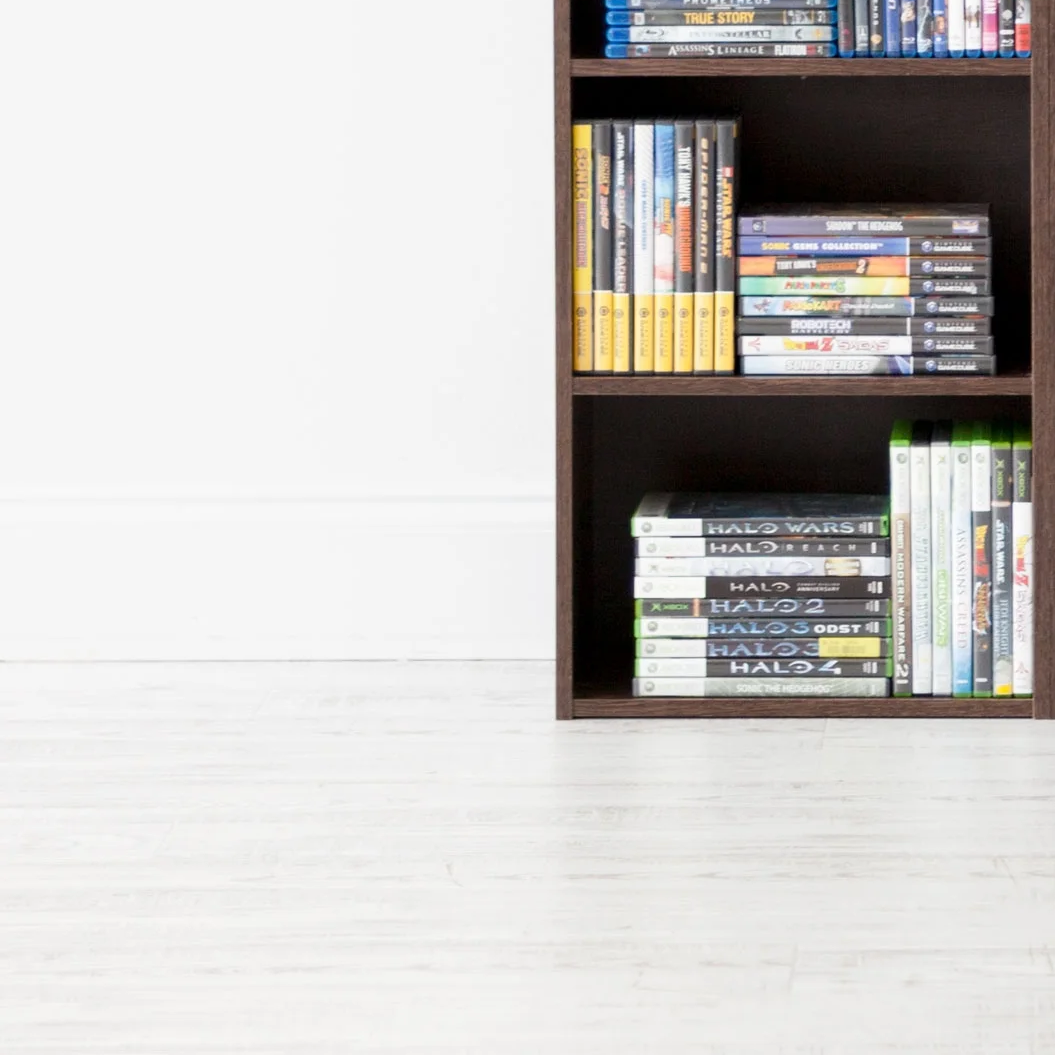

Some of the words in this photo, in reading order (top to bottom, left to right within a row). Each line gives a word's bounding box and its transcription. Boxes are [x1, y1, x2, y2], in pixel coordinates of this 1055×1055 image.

[683, 13, 714, 25] TRUE
[717, 12, 755, 24] STORY
[717, 46, 764, 55] LINEAGE
[616, 132, 625, 158] STAR
[678, 146, 691, 170] TONY
[575, 148, 589, 200] SONIC
[616, 159, 625, 186] WARS
[678, 172, 691, 207] HAWK'S
[700, 138, 709, 257] SPIDER-MAN
[722, 178, 732, 218] STAR
[677, 207, 692, 273] UNDERGROUND
[722, 218, 732, 258] WARS
[614, 241, 627, 293] LEADER
[700, 262, 708, 274] 2
[856, 259, 867, 273] 2
[790, 320, 852, 329] ROBOTECH
[785, 360, 821, 372] SONIC
[823, 360, 870, 372] HEROES
[996, 471, 1004, 497] XBOX
[707, 522, 780, 534] HALO
[785, 522, 855, 533] WARS
[996, 519, 1005, 551] STAR
[710, 541, 780, 553] HALO
[896, 553, 905, 603] MODERN
[995, 551, 1005, 585] WARS
[729, 582, 791, 592] HALO
[710, 599, 799, 614] HALO
[804, 598, 826, 614] 2
[999, 599, 1009, 619] JEDI
[708, 622, 788, 634] HALO
[790, 622, 810, 634] 3
[813, 624, 862, 634] ODST
[896, 606, 906, 661] WARFARE
[957, 602, 969, 649] CREED
[708, 641, 800, 656] HALO
[803, 641, 820, 656] 3
[999, 620, 1009, 656] KNIGHT
[730, 661, 816, 674] HALO
[818, 660, 842, 675] 4
[895, 662, 909, 678] 2
[736, 684, 763, 693] SONIC
[765, 684, 780, 693] THE
[781, 684, 831, 693] HEDGEHOG
